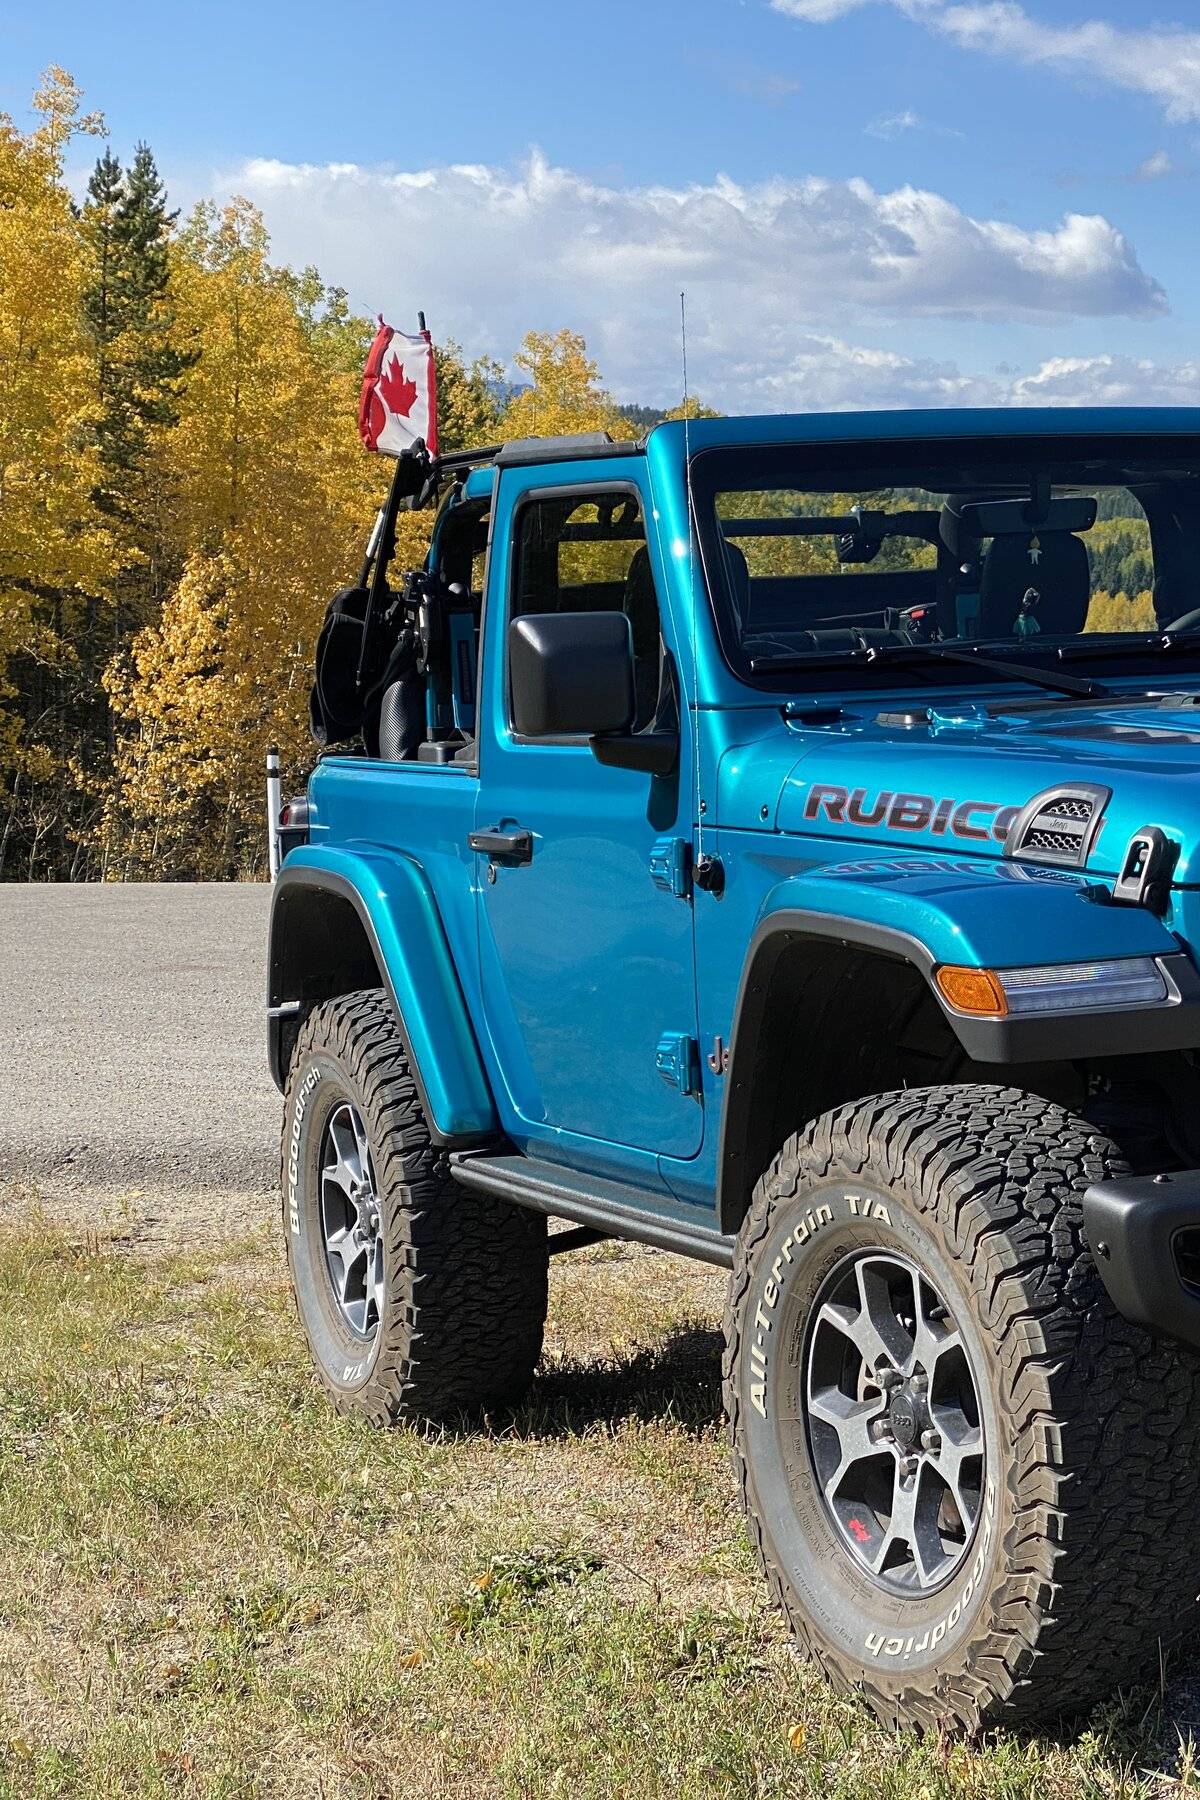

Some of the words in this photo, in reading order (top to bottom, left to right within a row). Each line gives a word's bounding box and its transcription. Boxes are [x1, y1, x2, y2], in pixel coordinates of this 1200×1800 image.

[804, 784, 1106, 854] RUBIC
[288, 1066, 322, 1236] BFGoodrich
[750, 1203, 834, 1419] All-Terrain
[844, 1195, 893, 1226] T/A
[864, 1474, 996, 1661] BFGoodrich
